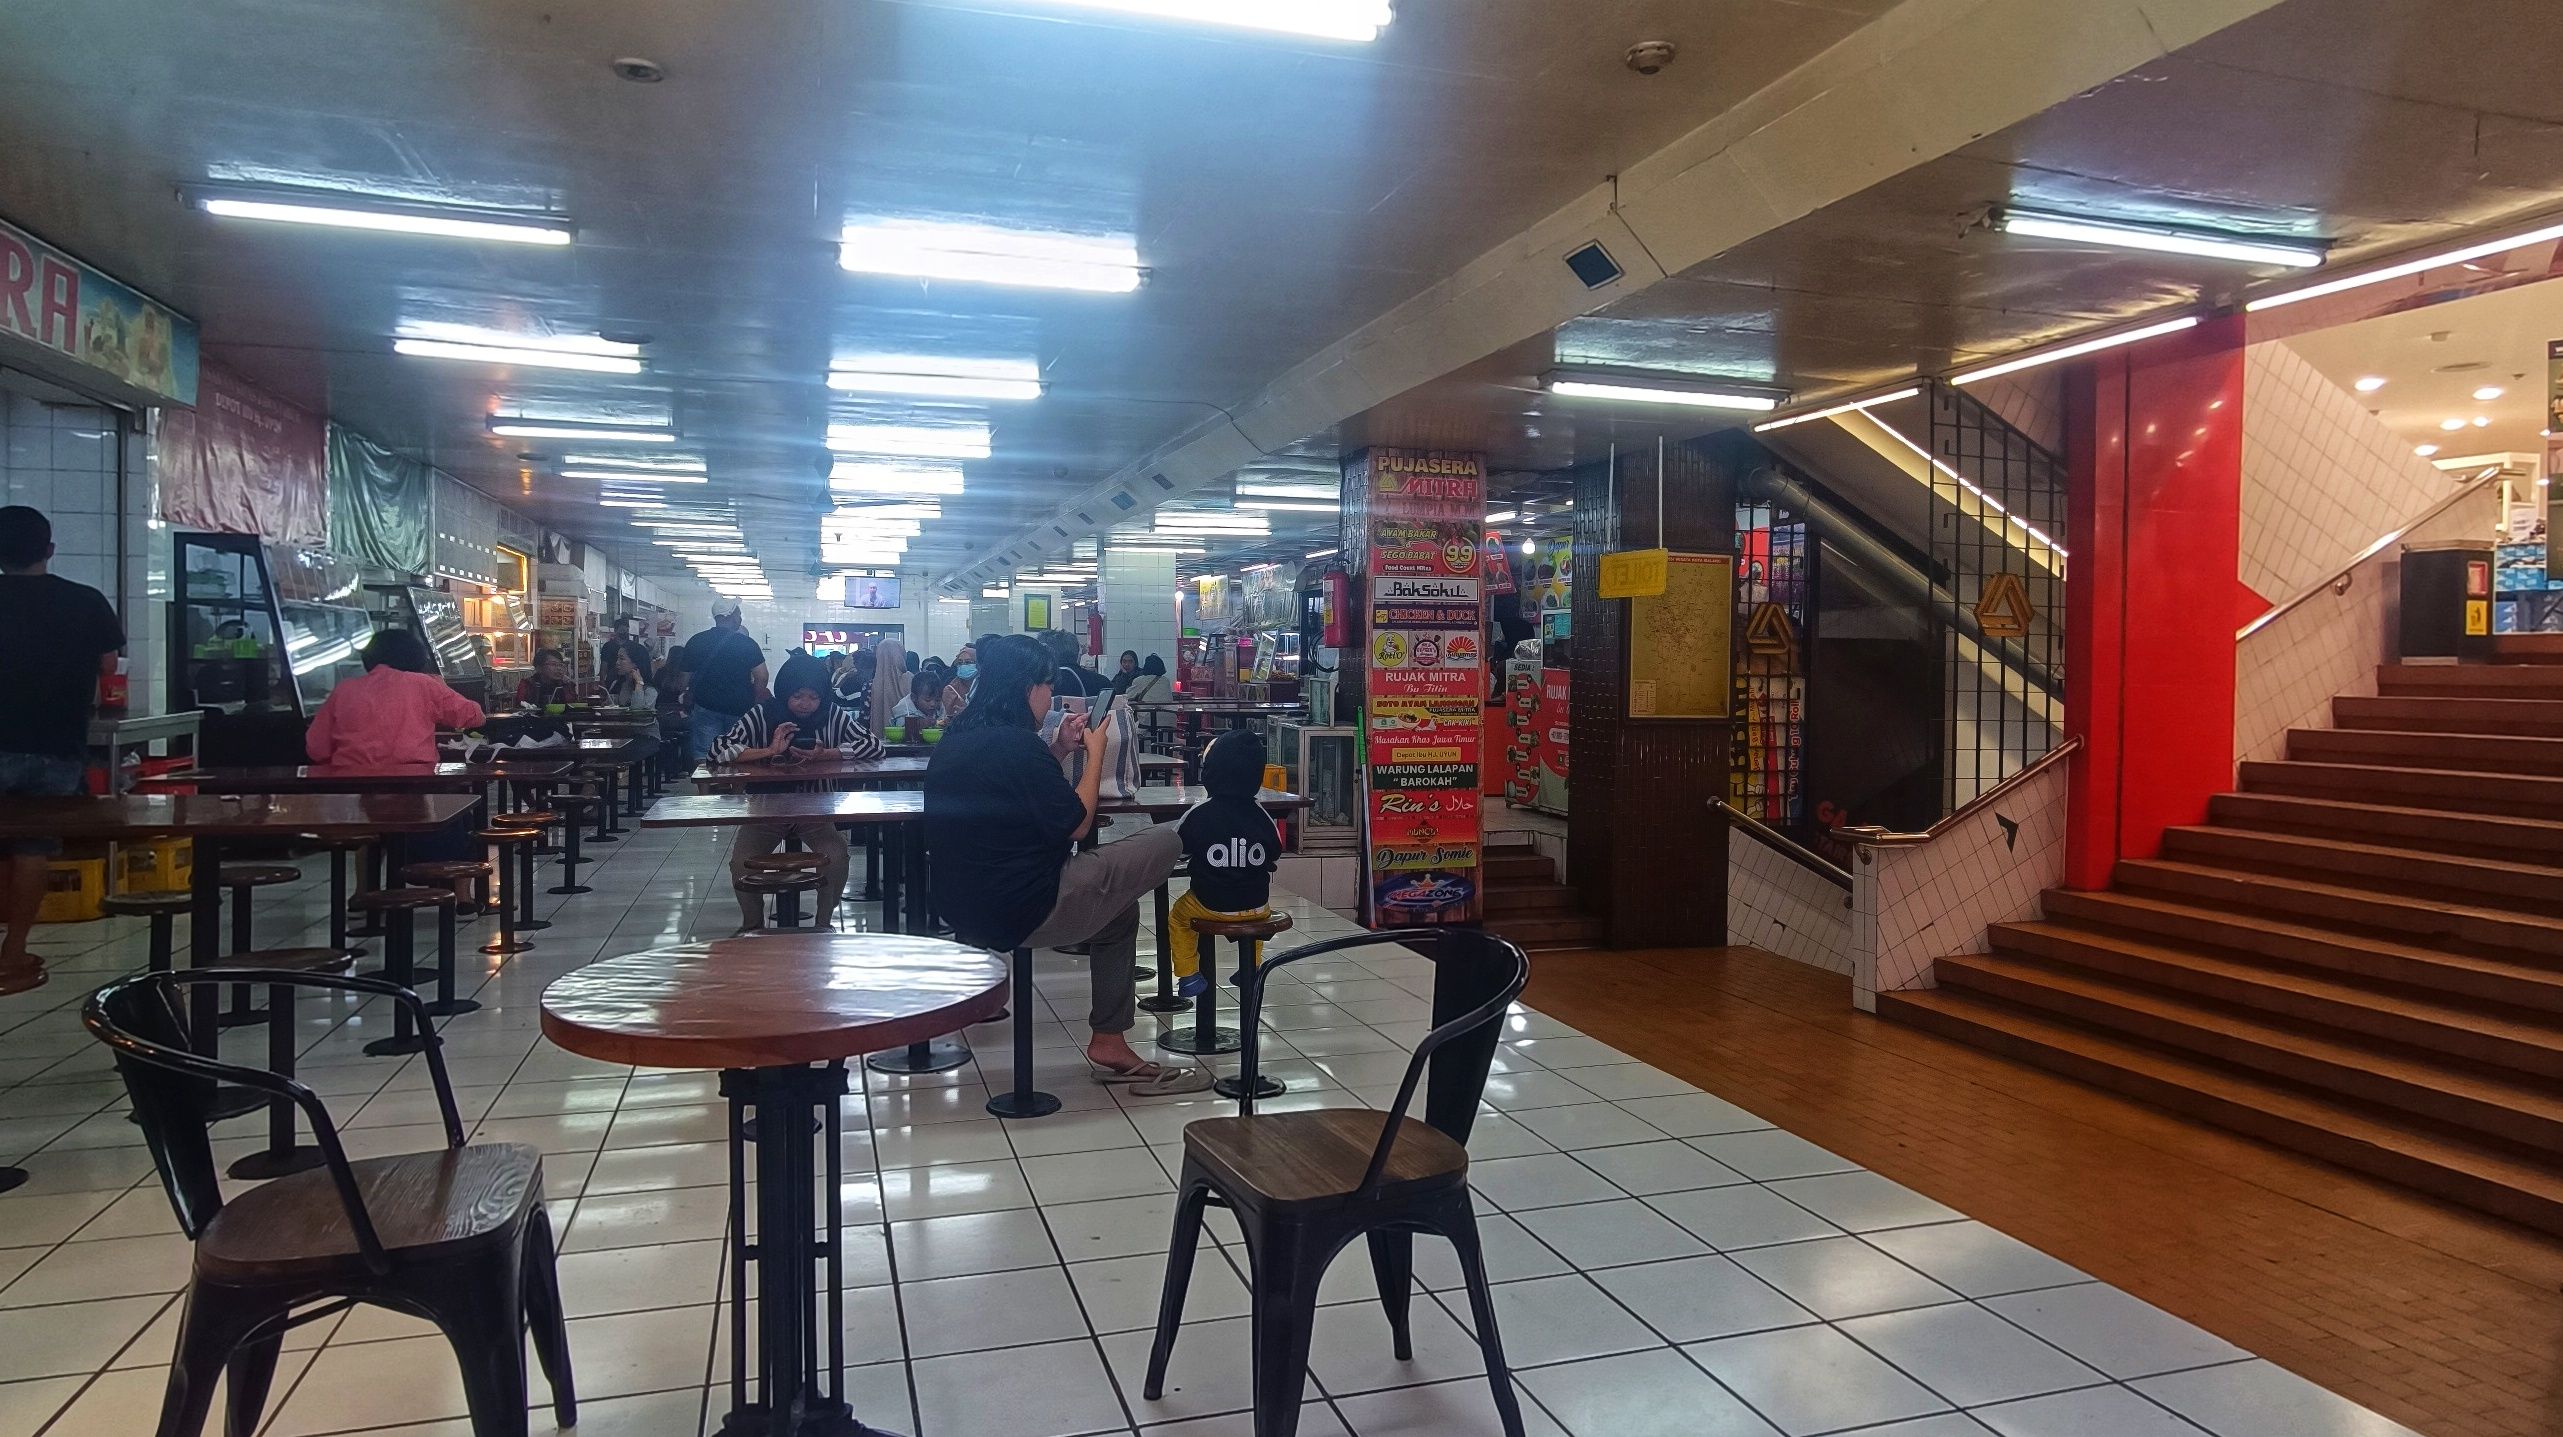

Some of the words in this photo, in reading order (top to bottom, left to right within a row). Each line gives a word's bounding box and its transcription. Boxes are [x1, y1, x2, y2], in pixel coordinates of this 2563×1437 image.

[1378, 456, 1478, 475] PUJASERA
[1399, 476, 1478, 498] MITRA
[1407, 530, 1438, 539] BAKAR
[1446, 545, 1473, 562] 99
[1389, 609, 1435, 620] CHICKEN
[1436, 610, 1445, 621] &
[1446, 610, 1476, 621] DUCK
[1385, 672, 1426, 682] RUJAK
[1429, 672, 1466, 682] MITRA
[1403, 685, 1419, 693] Bu
[1546, 685, 1567, 700] RUJAK
[1376, 700, 1400, 708] SOTO
[1401, 700, 1427, 708] AYAM
[1790, 700, 1800, 720] Roll
[1374, 734, 1409, 744] Masakan
[1411, 734, 1430, 744] Khas
[1431, 735, 1452, 746] Jawa
[1454, 735, 1477, 743] Timur
[1396, 751, 1415, 759] Depot
[1377, 766, 1425, 774] WARUNG
[1428, 765, 1473, 774] LALAPAN
[1380, 793, 1441, 814] Rin's
[1446, 795, 1473, 811] حلال
[1206, 838, 1266, 868] alio
[1377, 848, 1428, 869] Dapur
[1387, 887, 1464, 899] MEGAZONE
